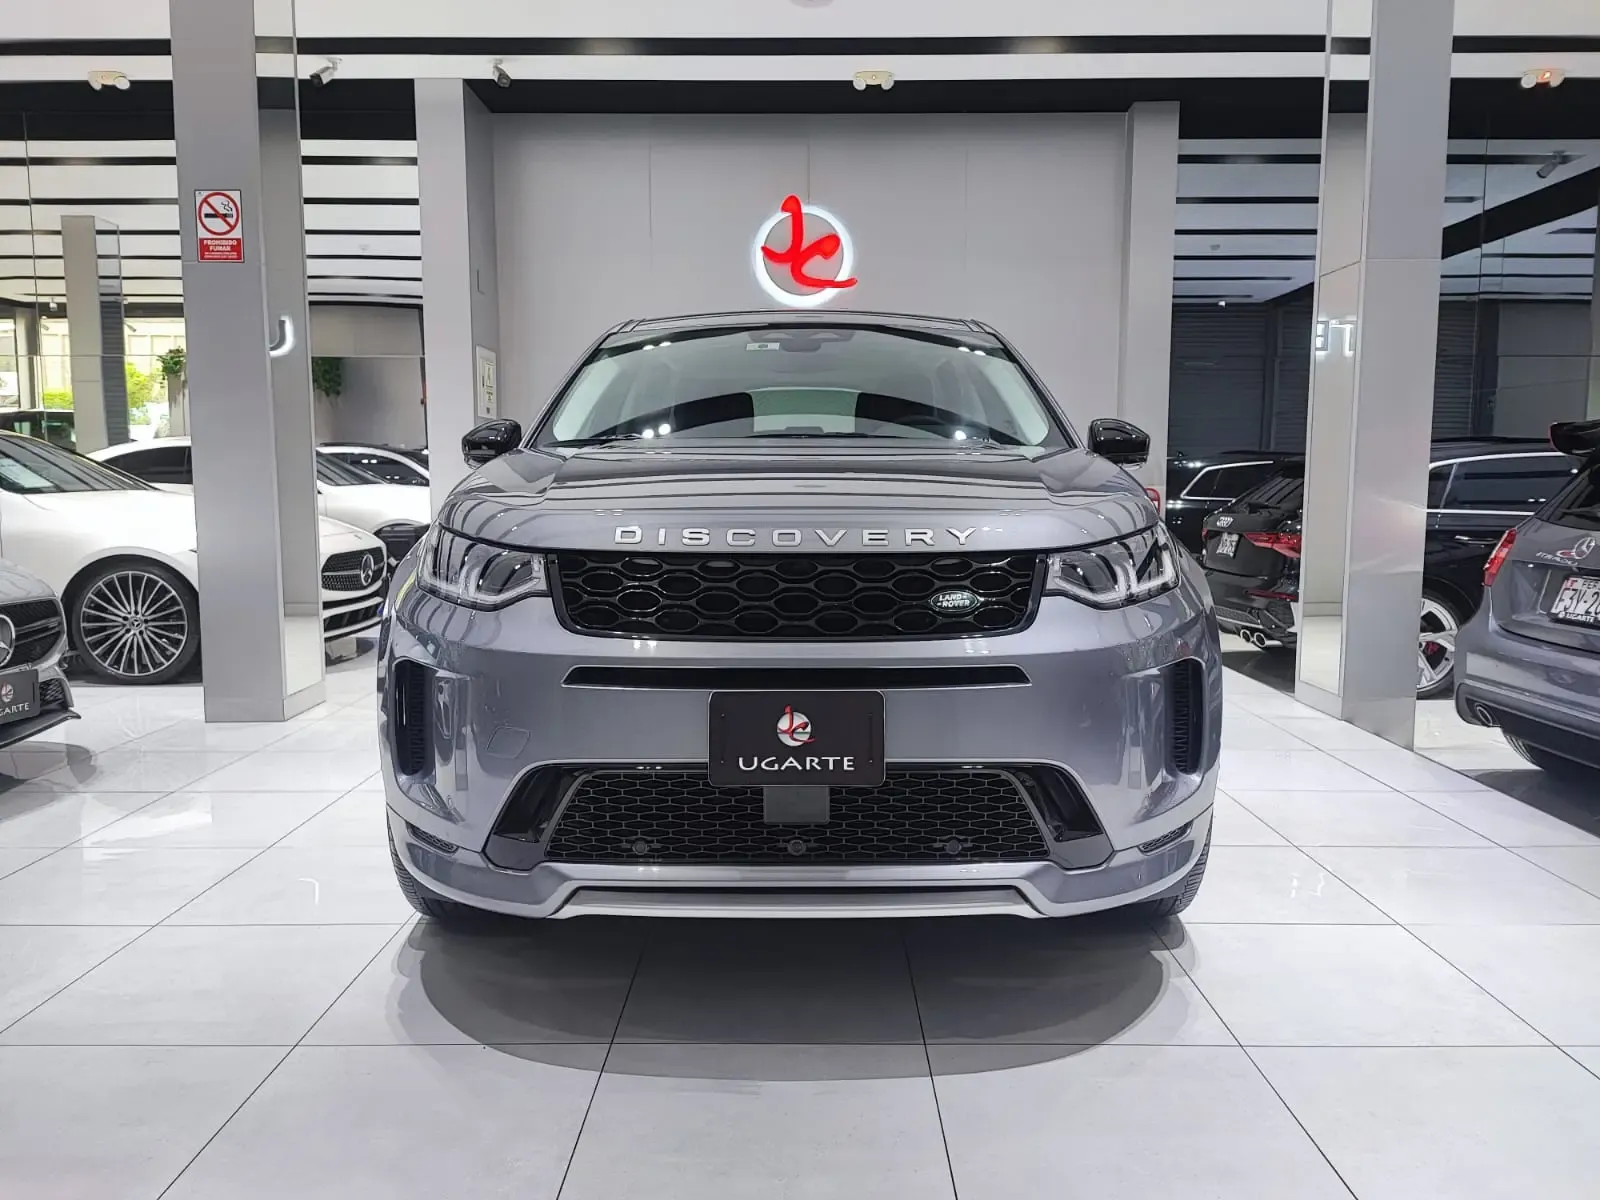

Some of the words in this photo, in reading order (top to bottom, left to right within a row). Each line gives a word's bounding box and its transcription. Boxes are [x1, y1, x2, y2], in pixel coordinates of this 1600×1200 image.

[614, 526, 976, 547] DISCOVERY
[939, 593, 962, 601] LAND
[942, 599, 970, 608] ROVER
[738, 756, 856, 771] UGARTE
